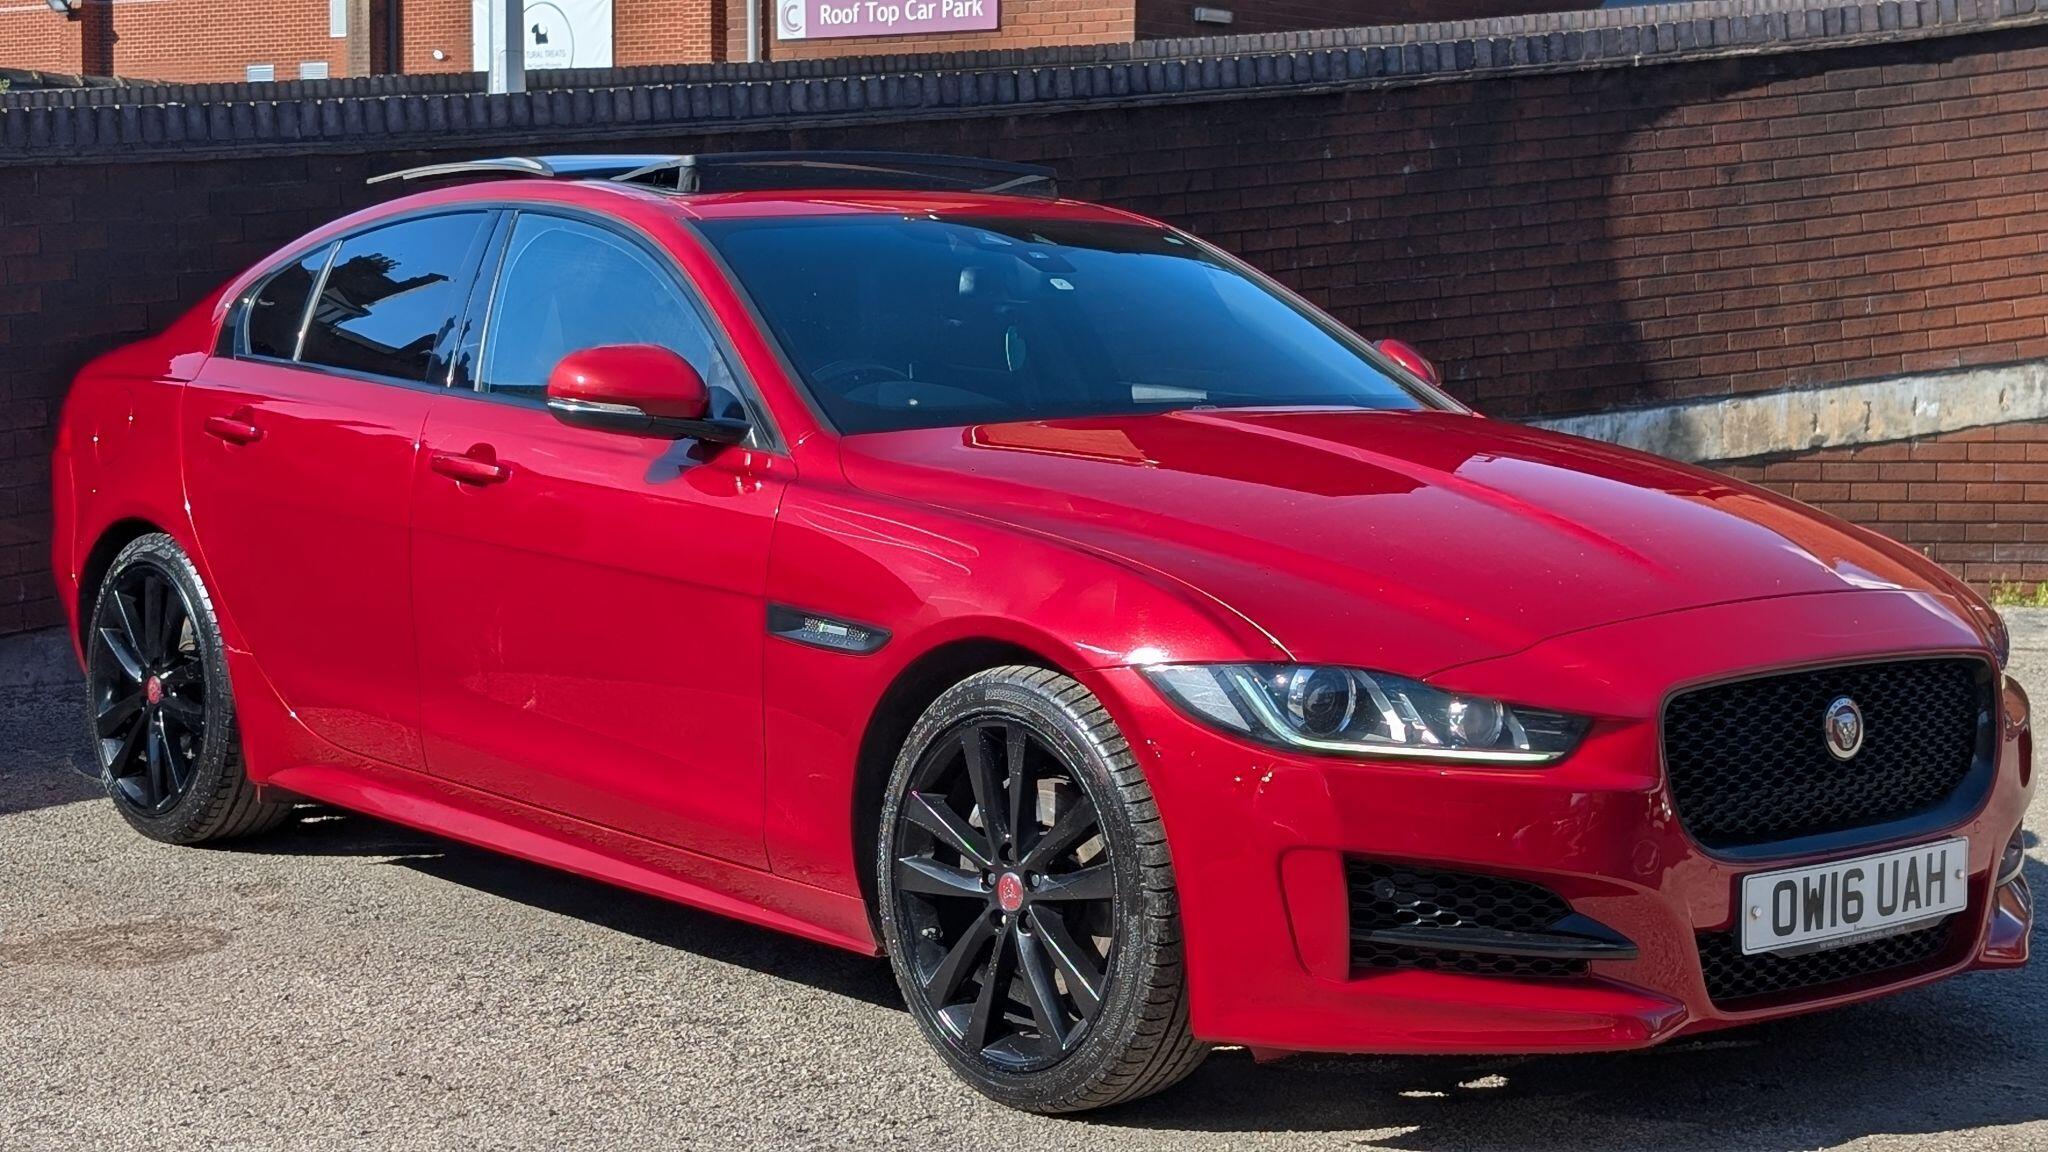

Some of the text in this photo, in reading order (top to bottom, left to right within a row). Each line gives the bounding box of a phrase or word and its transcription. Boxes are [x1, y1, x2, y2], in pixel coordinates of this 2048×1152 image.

[820, 0, 983, 26] Roof Top Car Park
[1772, 850, 1947, 937] OW16 UAH
